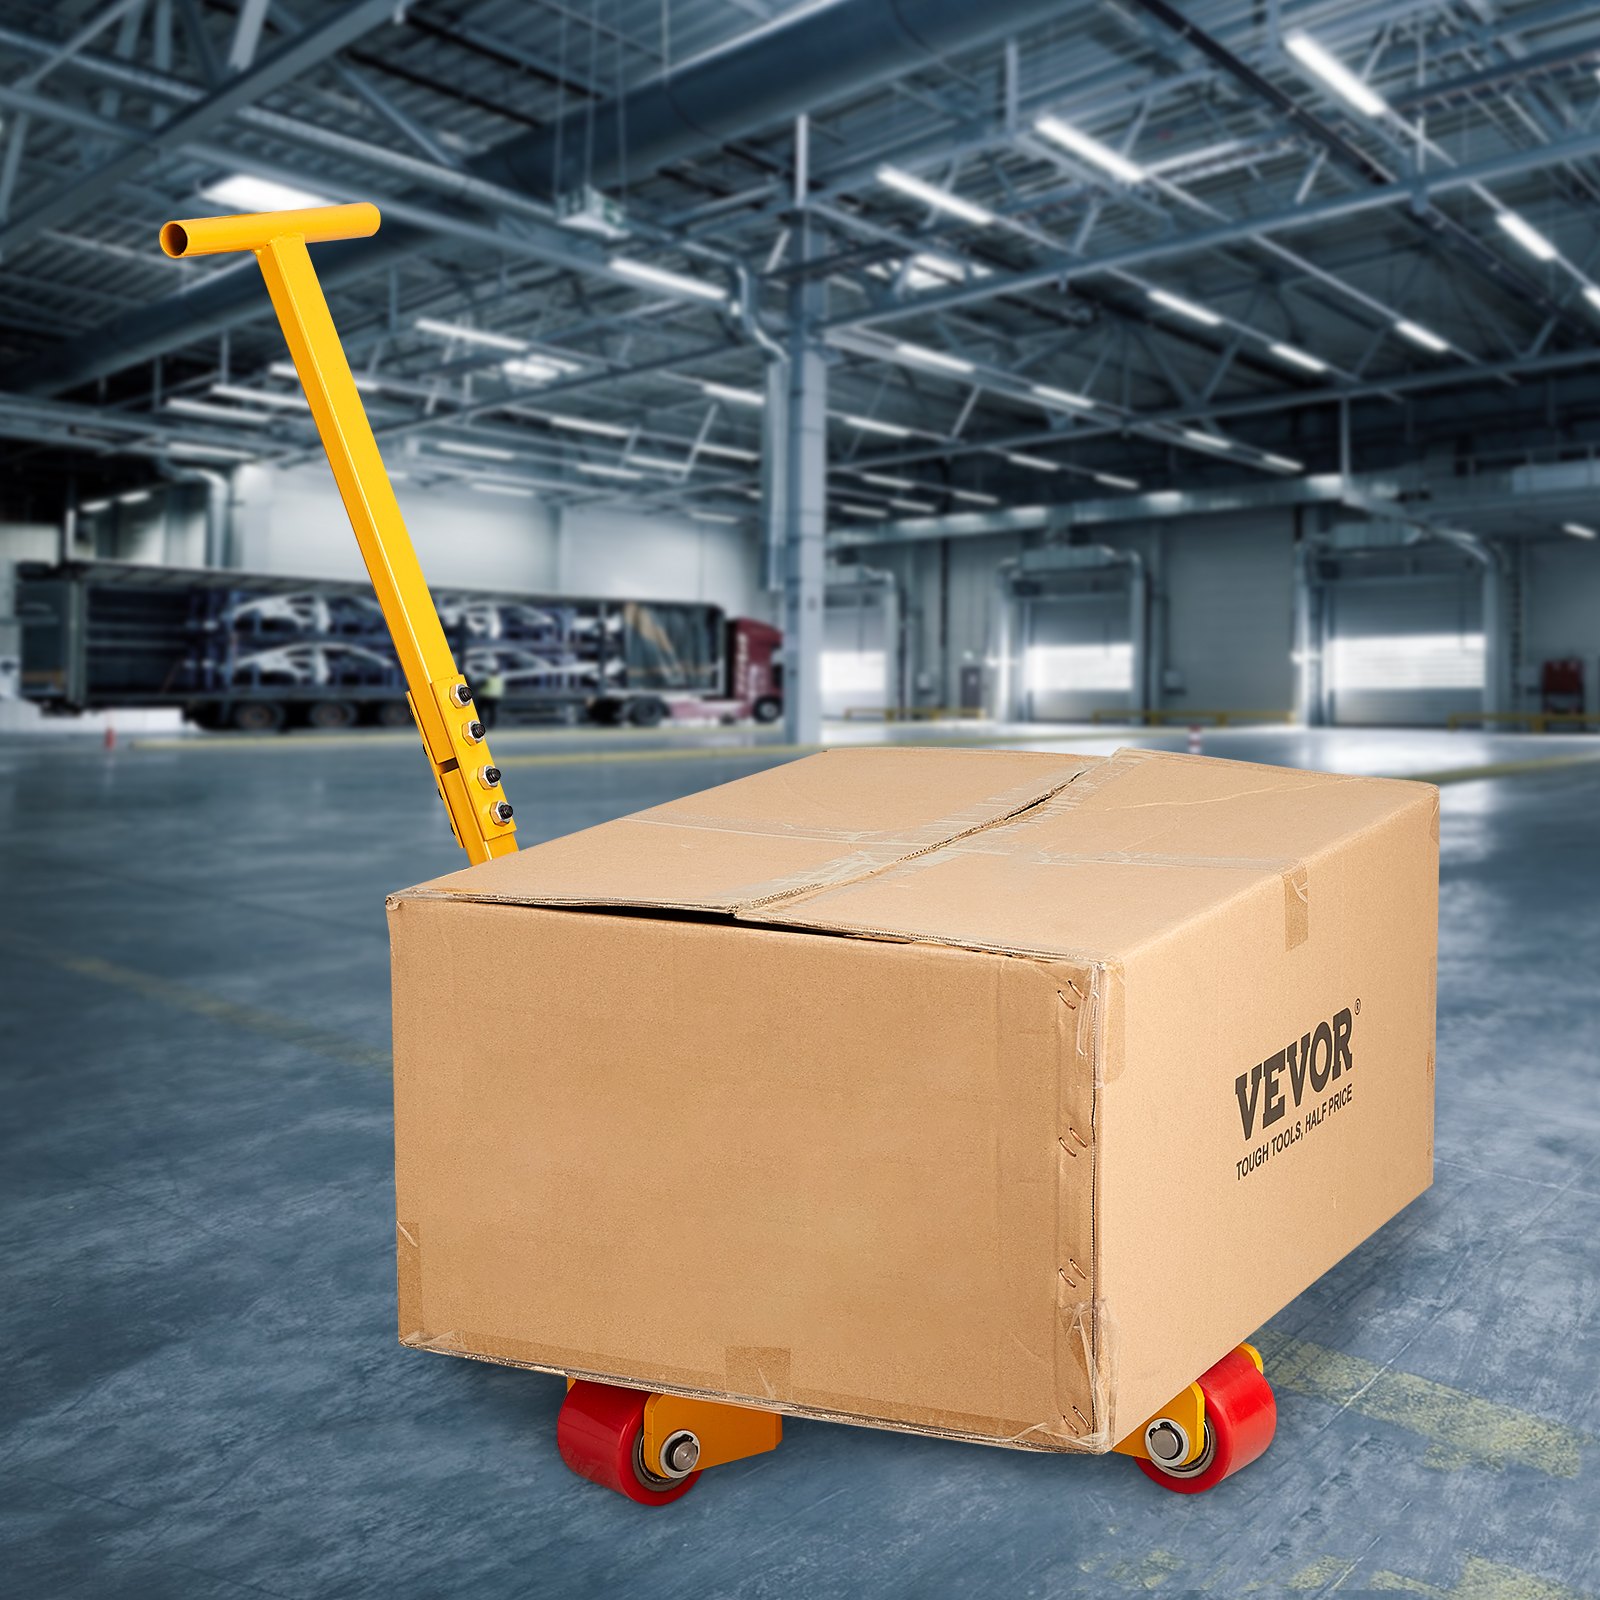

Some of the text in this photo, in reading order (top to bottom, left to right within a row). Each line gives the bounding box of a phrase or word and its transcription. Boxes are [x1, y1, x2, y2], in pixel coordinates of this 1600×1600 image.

[1235, 1007, 1353, 1142] VEVOR
[1236, 1083, 1353, 1181] TOUGH TOOLS, HALF PRICE
